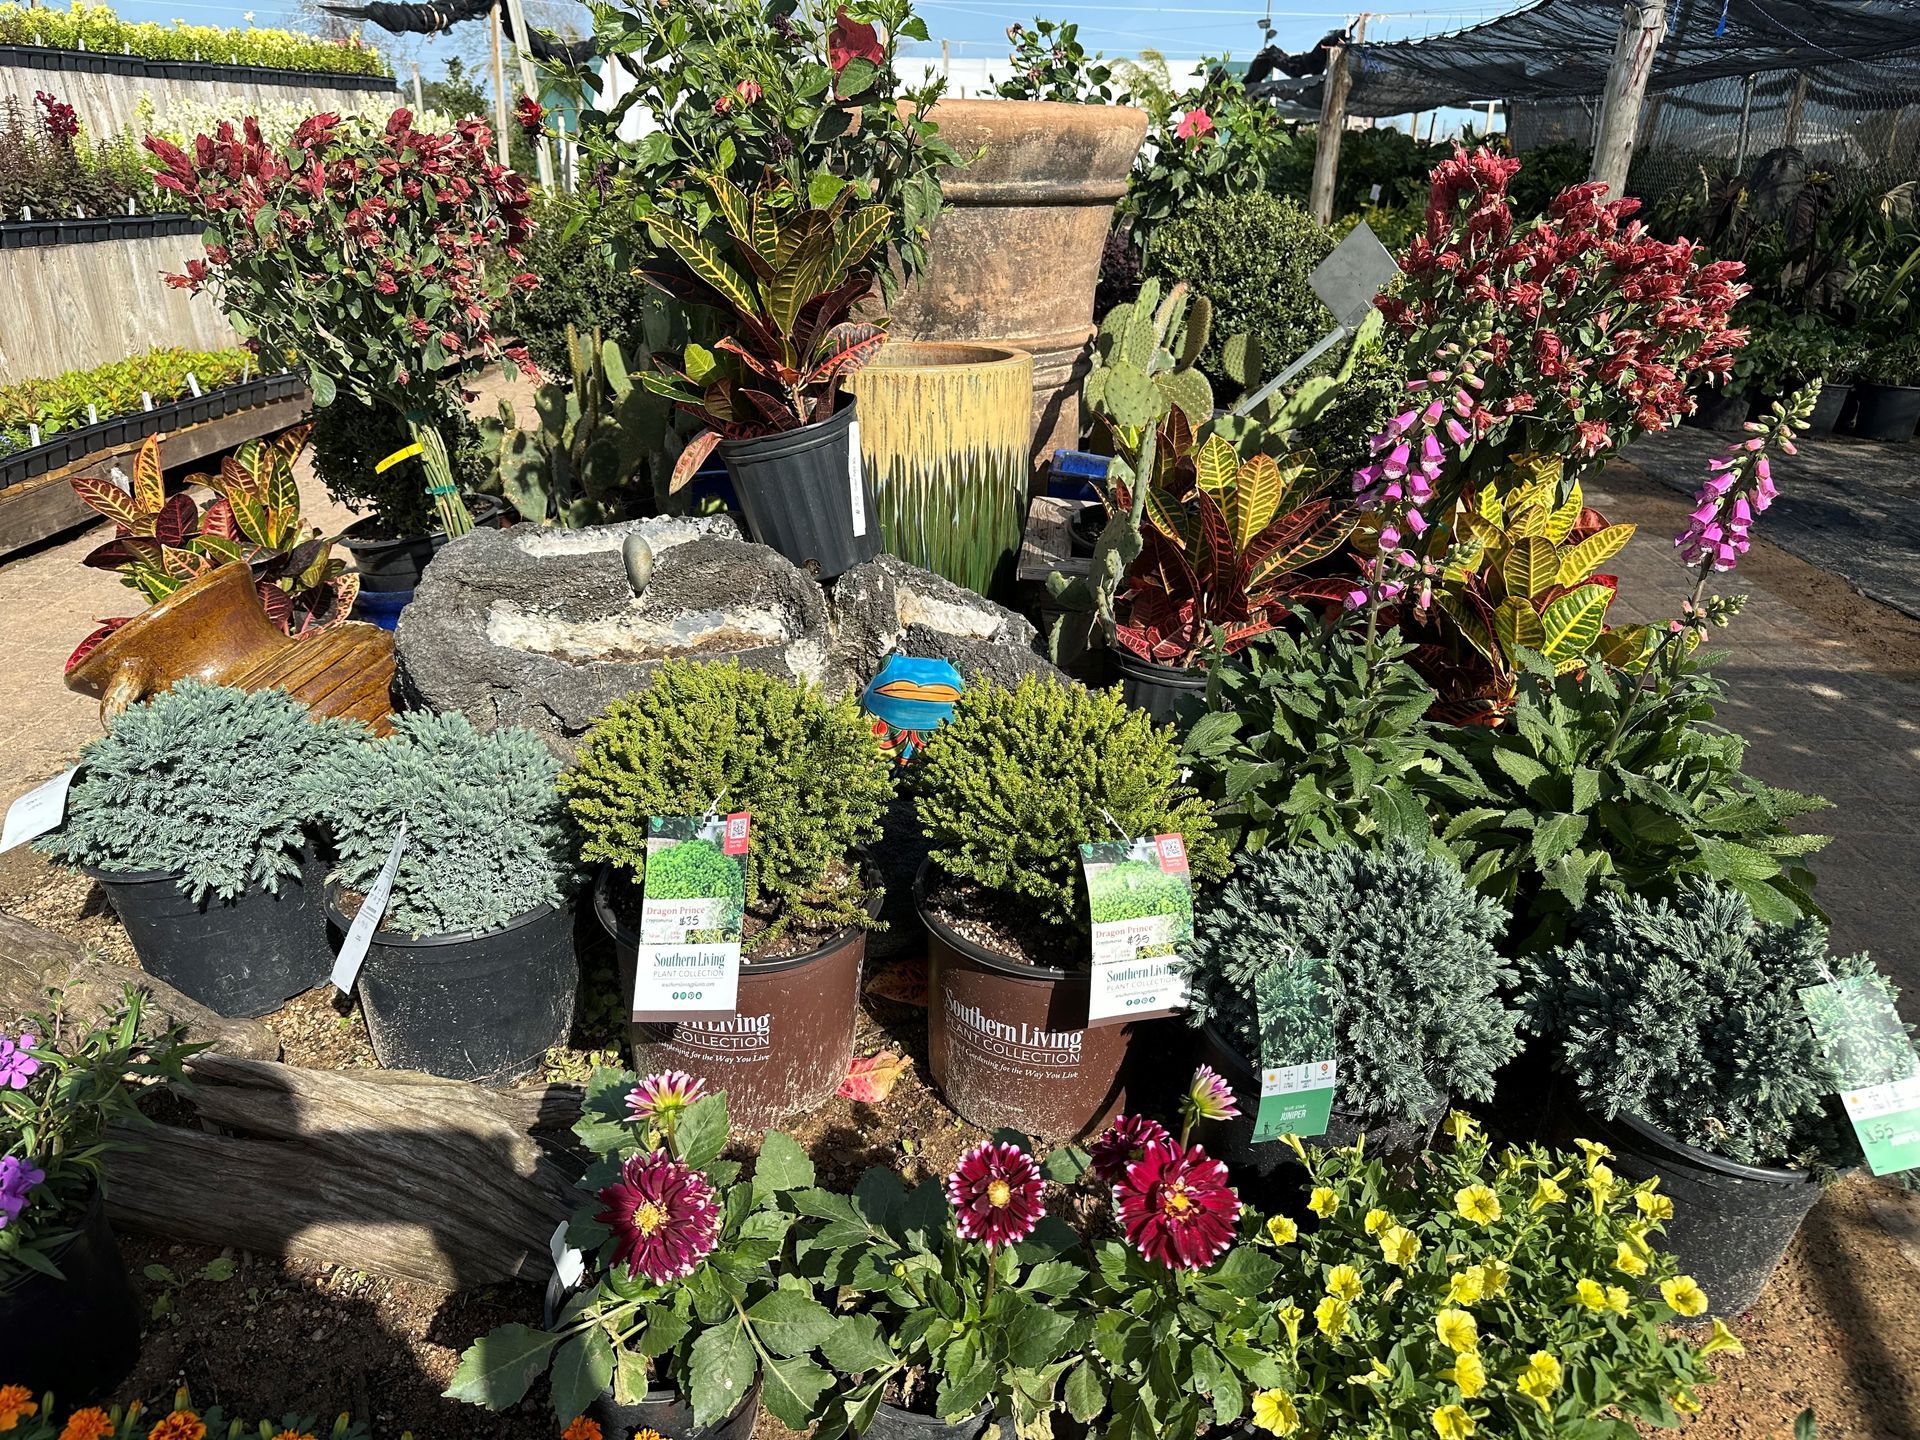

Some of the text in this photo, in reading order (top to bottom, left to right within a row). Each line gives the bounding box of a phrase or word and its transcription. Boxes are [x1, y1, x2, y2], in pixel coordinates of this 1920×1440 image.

[646, 906, 705, 916] Dragon Prince
[679, 915, 700, 926] $35
[1096, 924, 1153, 938] Dragon Prince
[1127, 933, 1150, 945] $35
[653, 951, 726, 969] Southern Living
[678, 969, 724, 977] COLLECTION
[1106, 963, 1178, 983] Southern Living
[1106, 977, 1177, 992] PLANT COLLECTION
[945, 986, 1084, 1053] Southern Living
[672, 1028, 770, 1048] COLLECTION
[945, 1011, 980, 1044] PLANT
[983, 1039, 1080, 1064] COLLECTION
[690, 1050, 701, 1060] for
[702, 1052, 714, 1061] the
[715, 1054, 734, 1065] Way
[736, 1055, 751, 1063] You
[753, 1053, 770, 1062] Live
[999, 1063, 1011, 1073] for
[1011, 1066, 1023, 1075] the
[1024, 1069, 1043, 1080] Way
[1045, 1071, 1060, 1079] You
[1061, 1071, 1079, 1080] Live
[1280, 1110, 1307, 1121] JUNIPER
